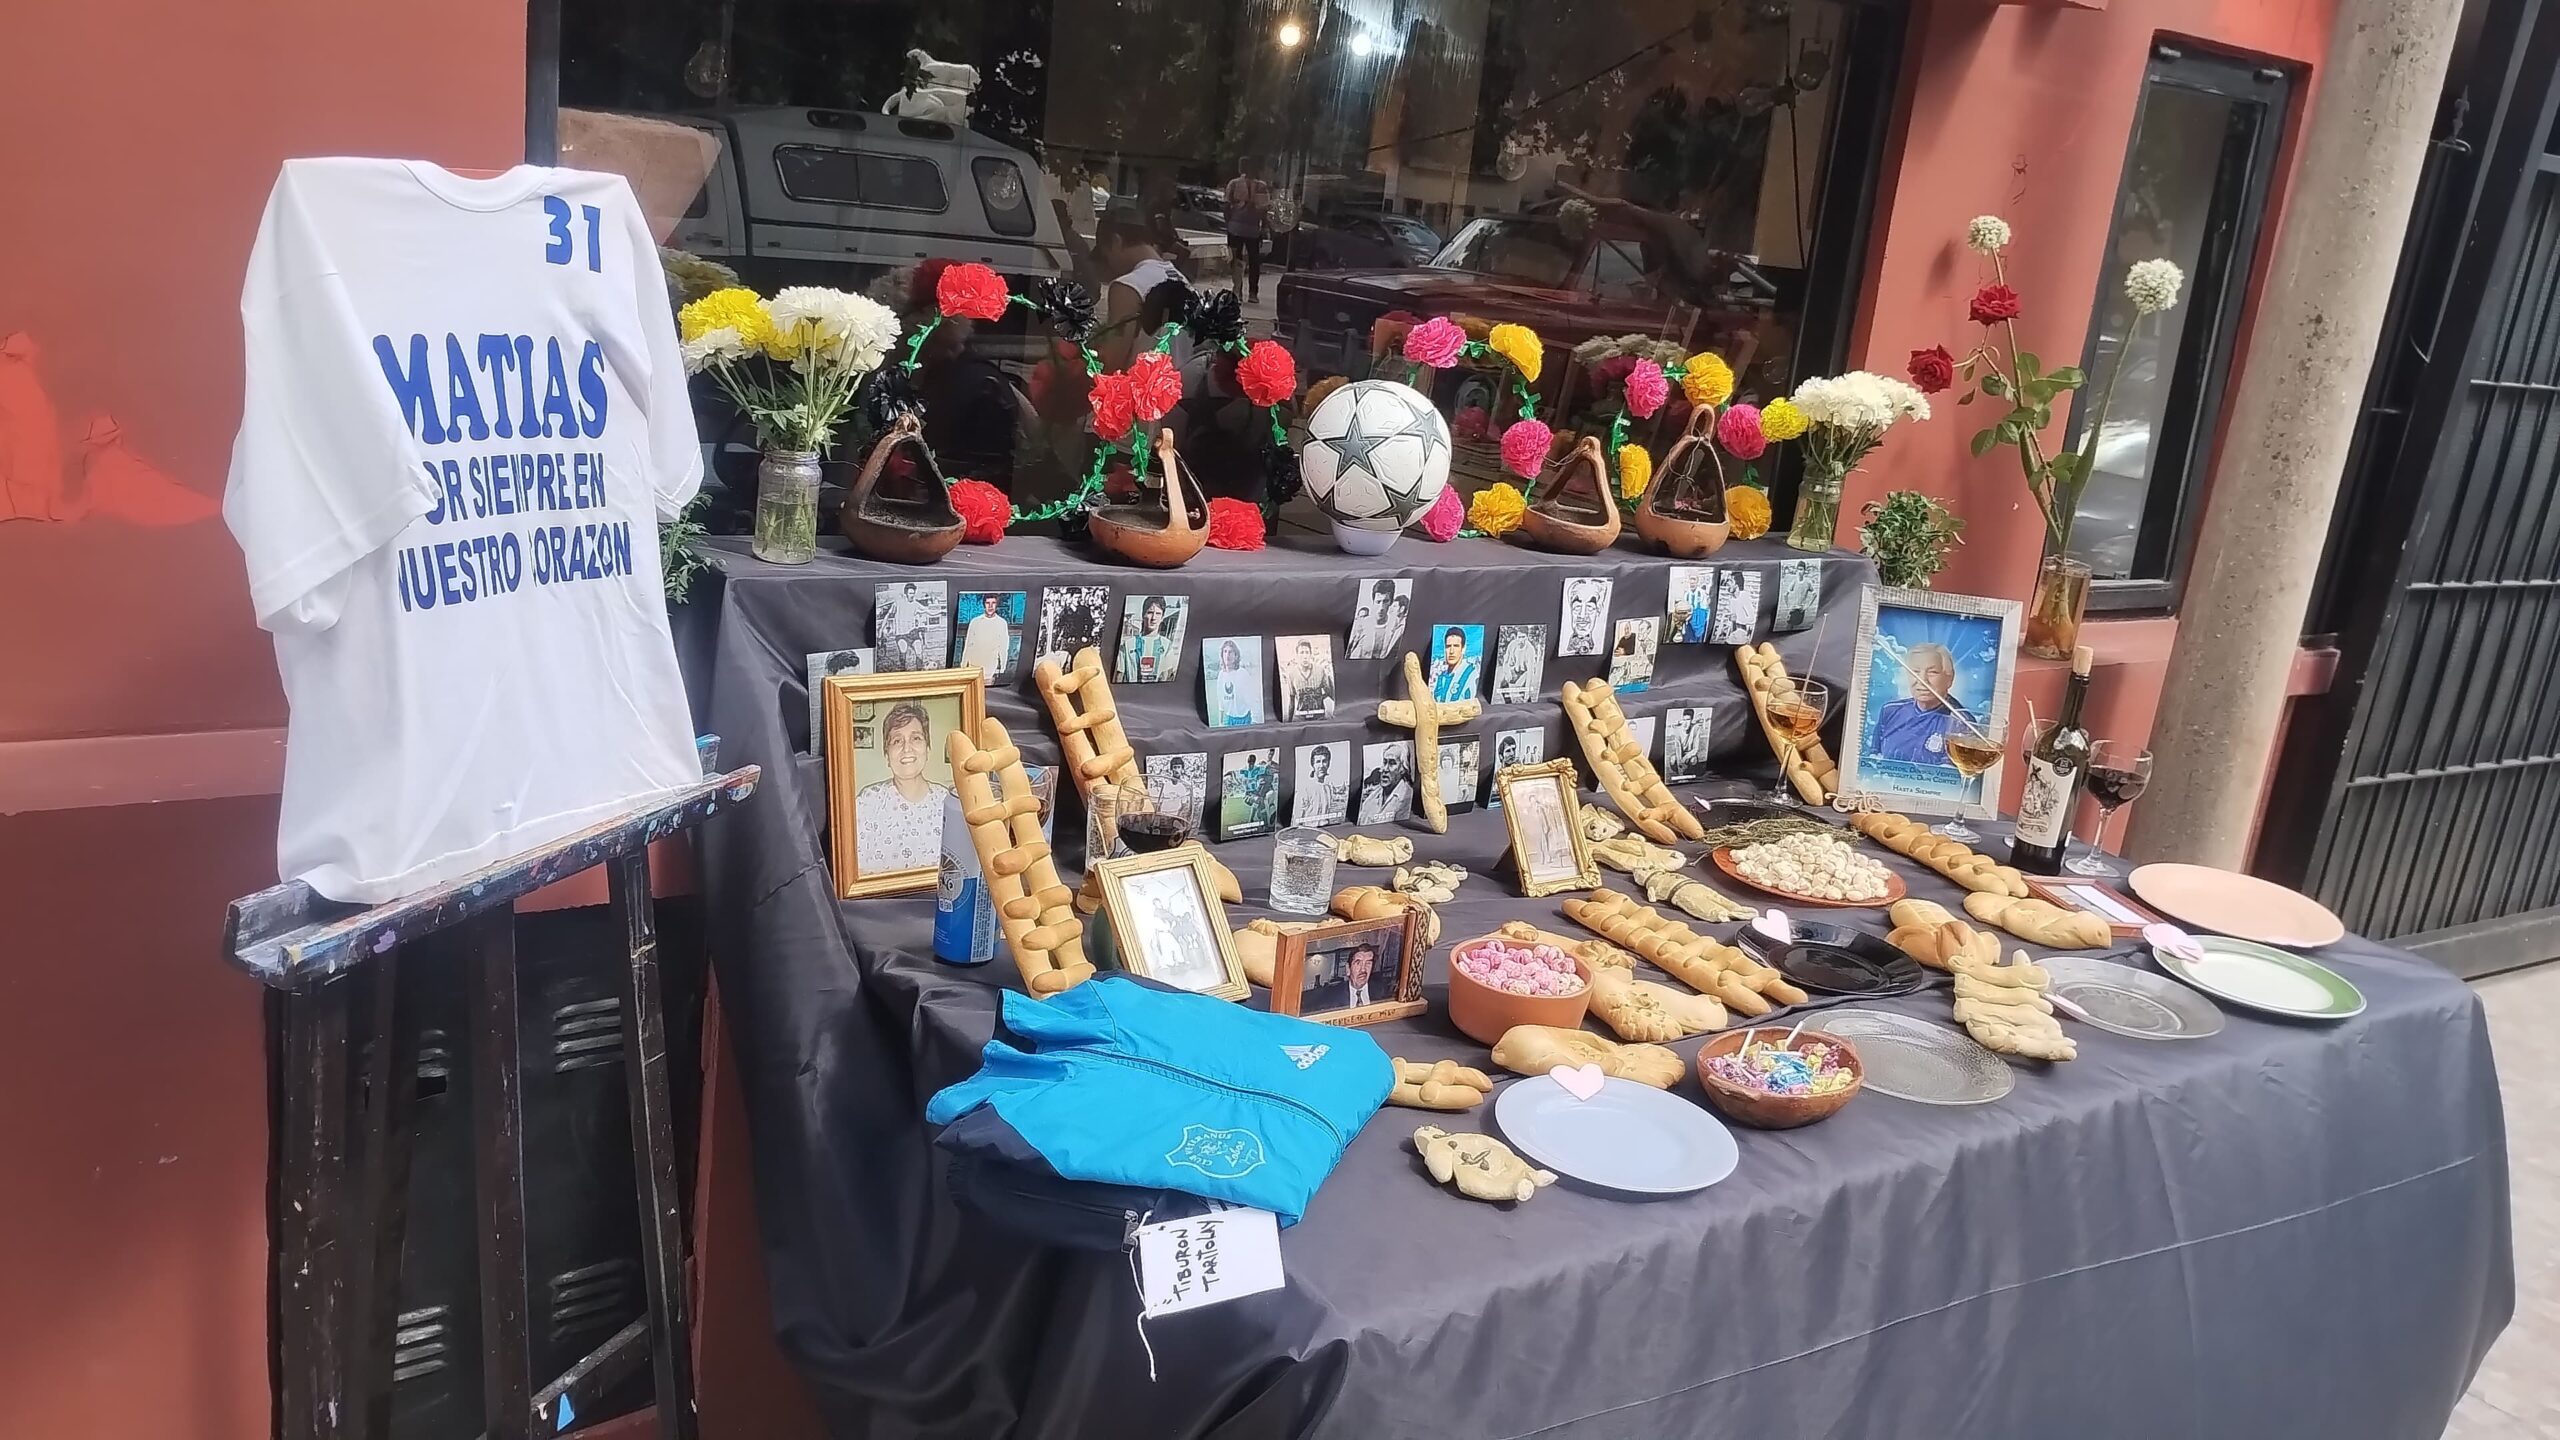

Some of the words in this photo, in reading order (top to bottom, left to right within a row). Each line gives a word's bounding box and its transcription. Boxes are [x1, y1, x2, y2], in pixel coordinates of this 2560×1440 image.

[544, 195, 602, 273] 31
[373, 333, 609, 444] MATIAS
[574, 452, 606, 510] EN
[527, 521, 633, 588] ORAZON
[1296, 1044, 1331, 1070] adidas
